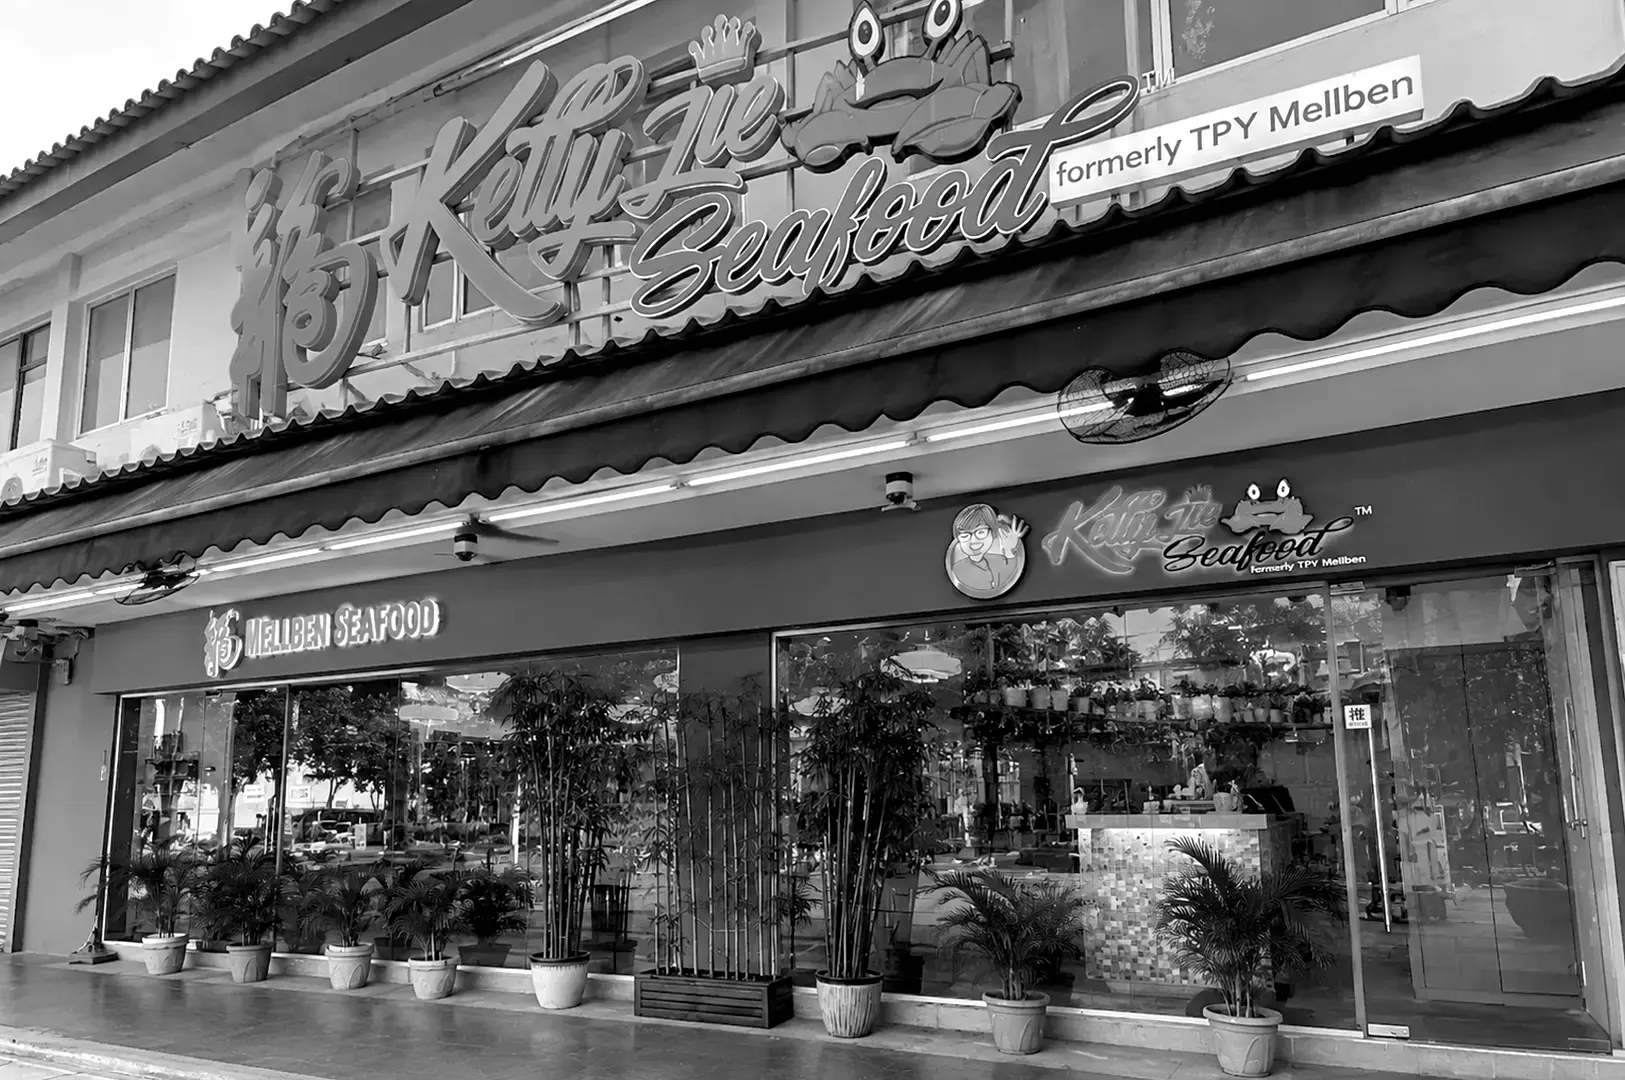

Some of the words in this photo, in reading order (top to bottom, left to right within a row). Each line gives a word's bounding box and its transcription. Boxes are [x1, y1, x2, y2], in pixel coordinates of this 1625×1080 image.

[1056, 136, 1182, 187] formerly
[1190, 111, 1258, 152] TPY
[1269, 74, 1414, 132] Mellben
[380, 55, 645, 325] Kelly
[629, 73, 1140, 318] Seafood
[1354, 505, 1373, 516] TM
[1163, 516, 1354, 572] Seafood
[1297, 559, 1319, 569] TPY
[1322, 555, 1367, 567] Mellben
[245, 612, 331, 658] MELLBEN
[334, 599, 440, 647] SEAFOOD
